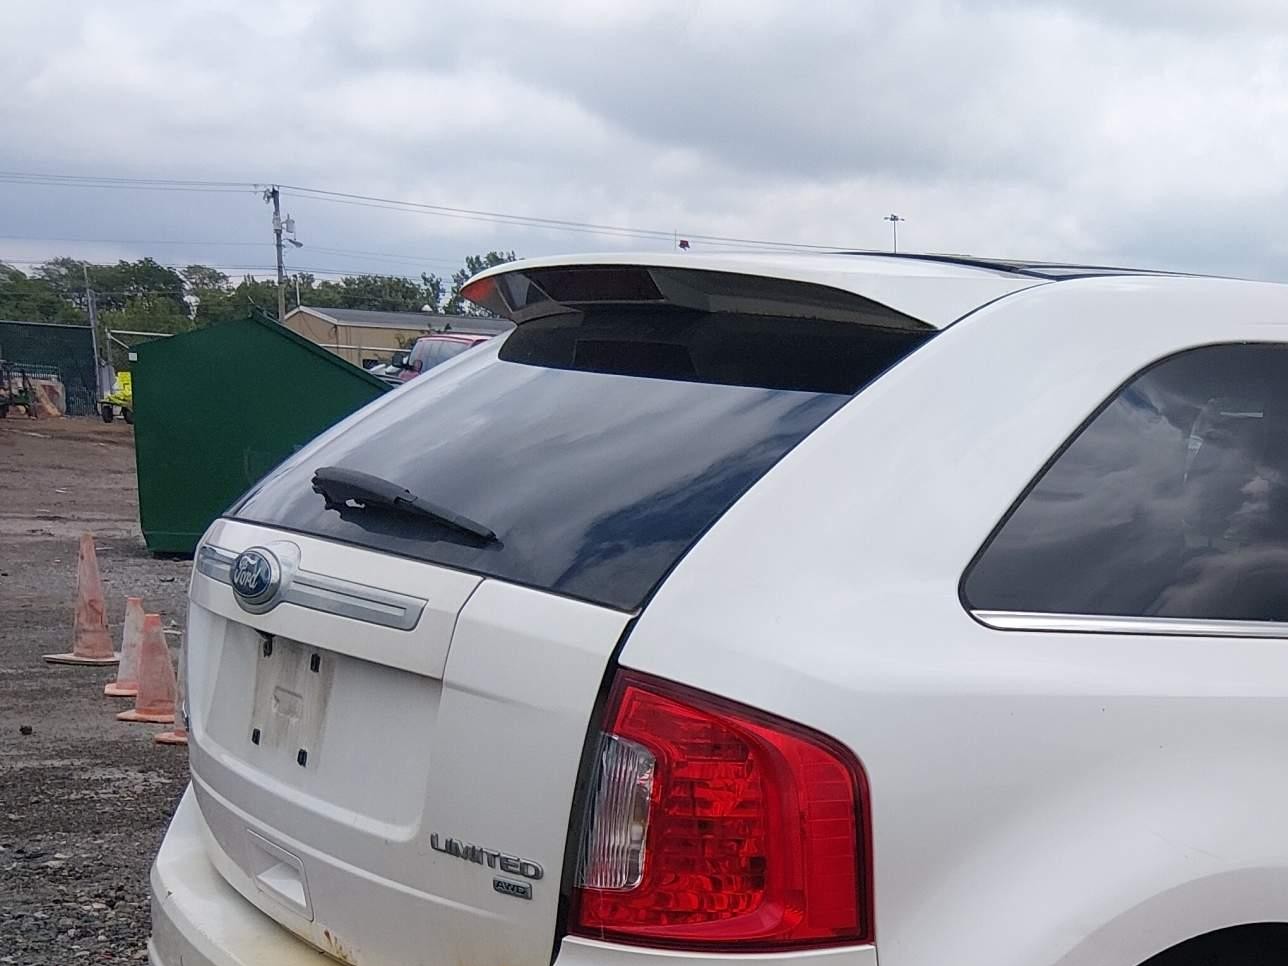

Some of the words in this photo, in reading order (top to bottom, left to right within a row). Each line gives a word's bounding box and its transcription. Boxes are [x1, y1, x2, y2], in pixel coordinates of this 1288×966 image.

[233, 555, 262, 589] Ford
[430, 832, 544, 880] LIMITED
[495, 880, 526, 895] AWD
